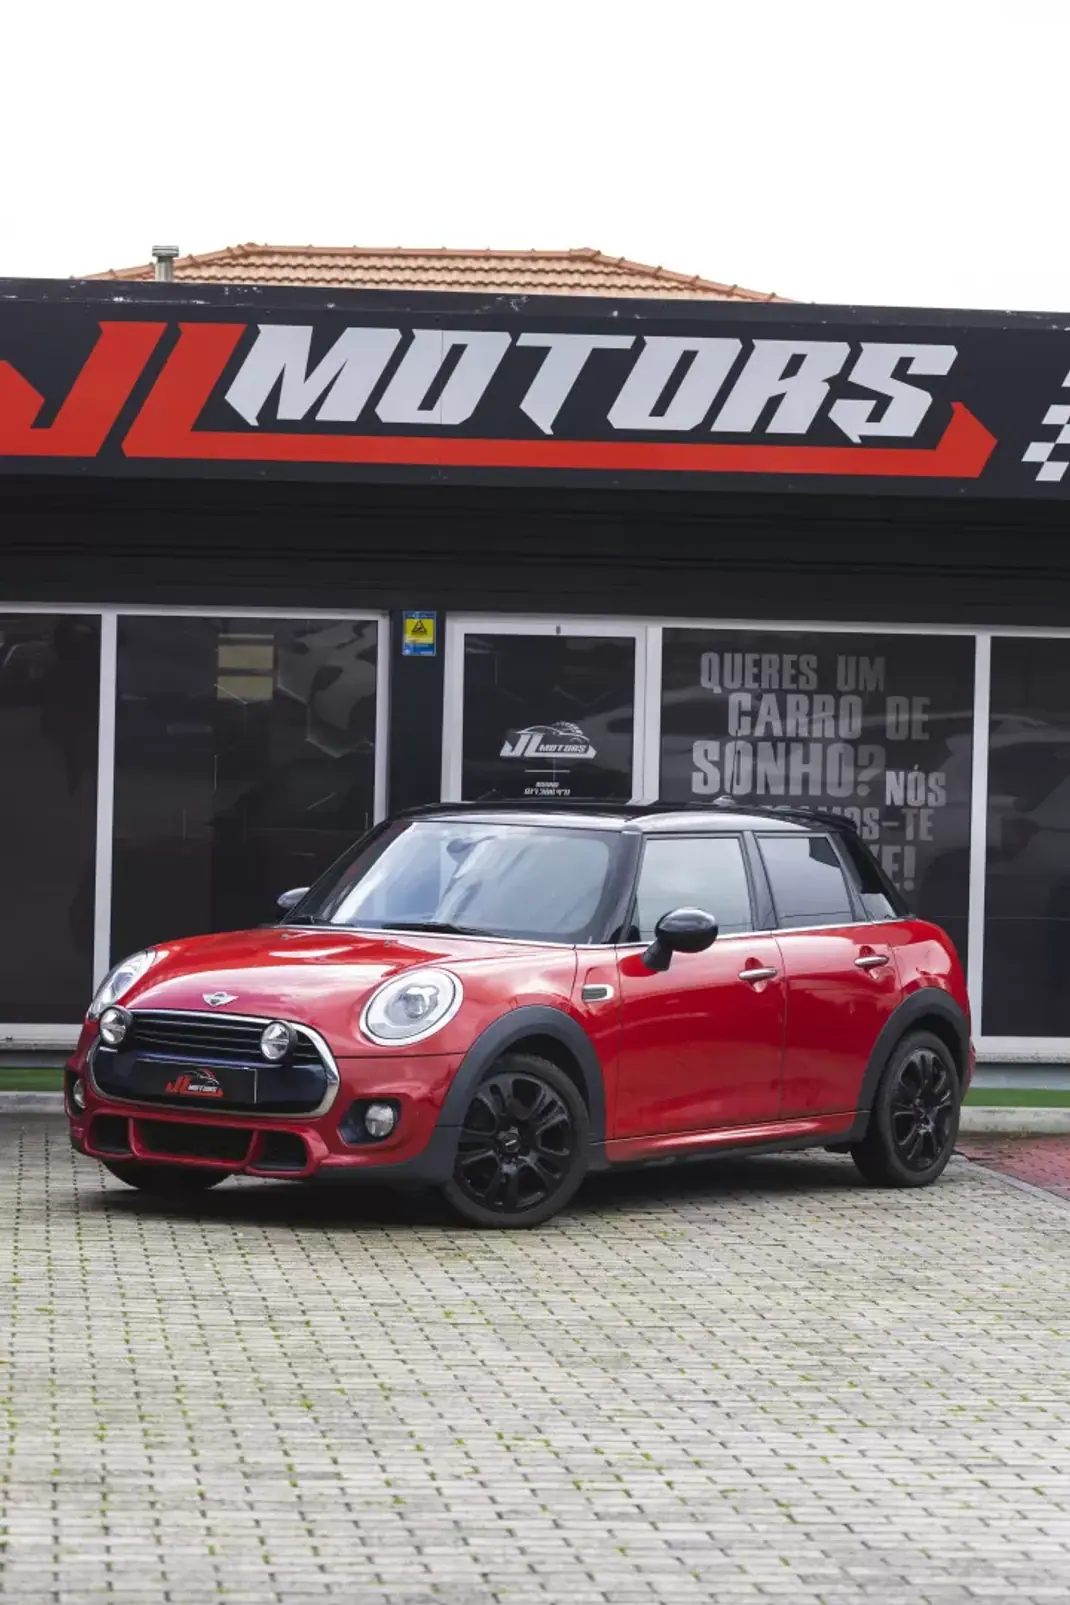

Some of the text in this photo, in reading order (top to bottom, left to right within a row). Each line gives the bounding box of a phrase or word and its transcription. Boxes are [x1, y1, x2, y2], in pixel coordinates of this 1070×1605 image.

[224, 323, 958, 443] MOTORS
[700, 652, 885, 693] QUERES UM
[728, 692, 930, 740] CARRO DE
[538, 744, 588, 754] MOTORS
[691, 740, 946, 807] SONHO? NÓS
